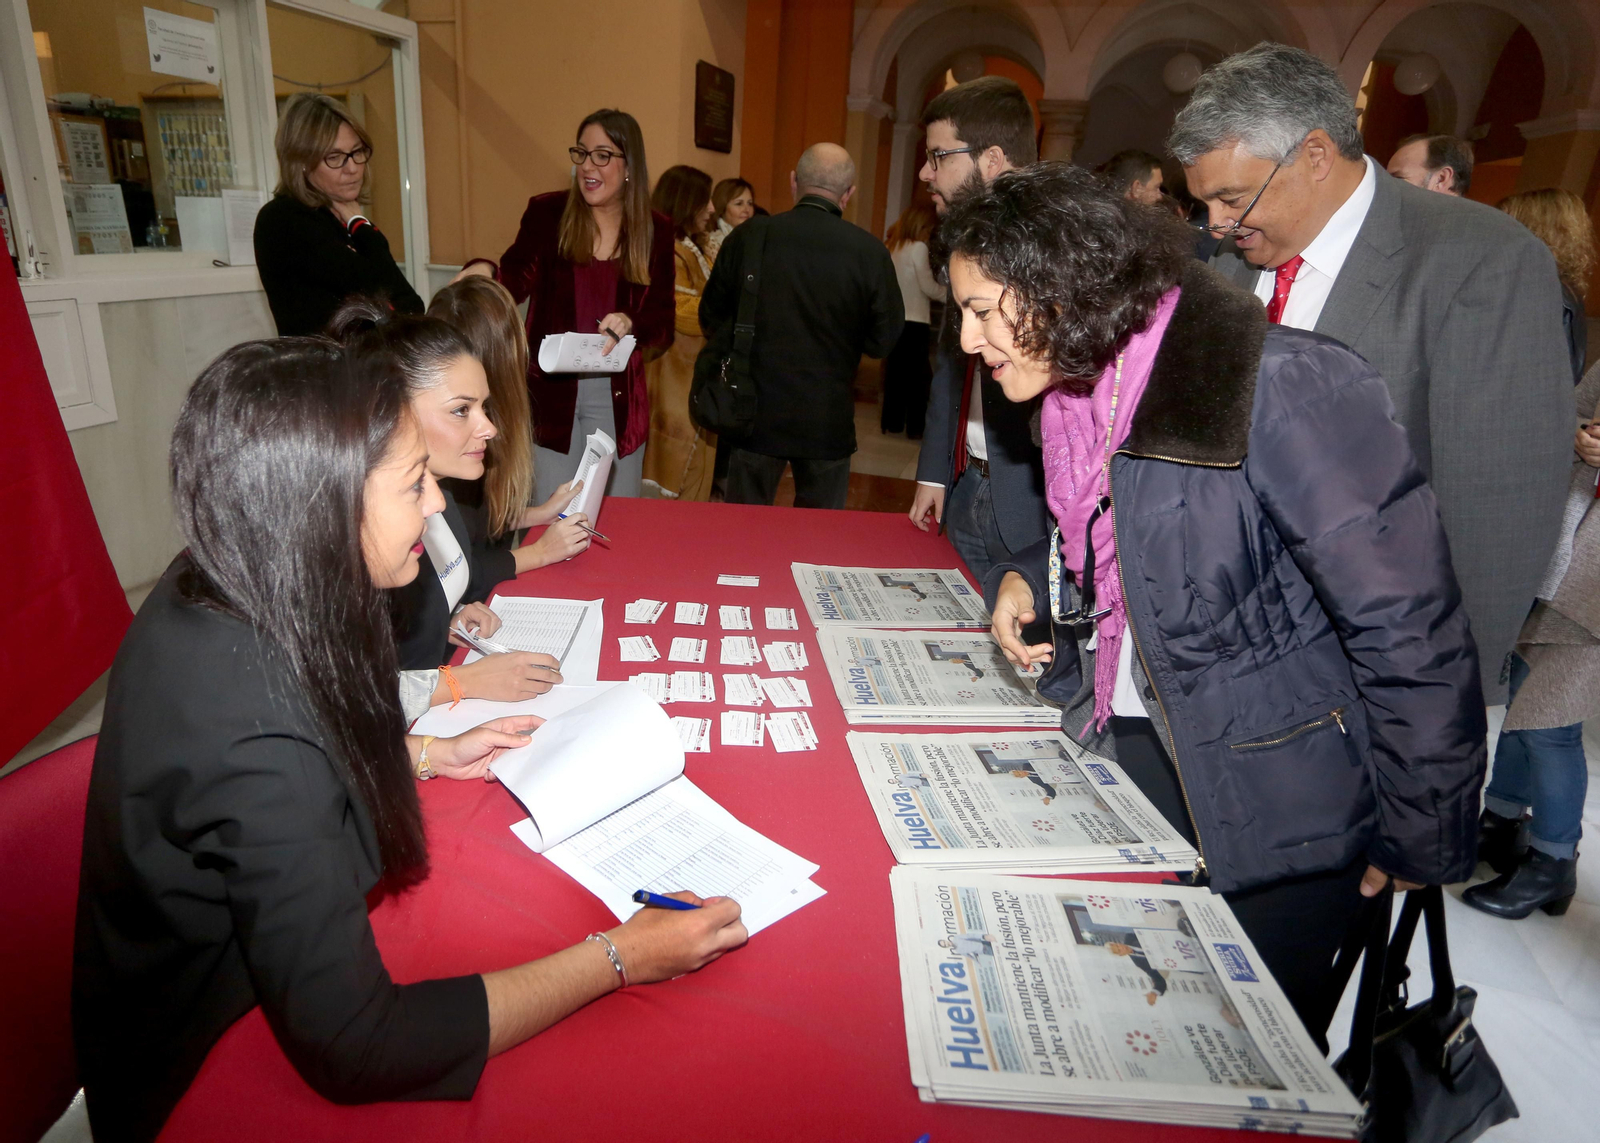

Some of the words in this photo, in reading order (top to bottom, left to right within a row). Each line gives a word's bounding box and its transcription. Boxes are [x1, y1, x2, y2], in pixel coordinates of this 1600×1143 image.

[816, 592, 842, 620] Huelva
[848, 668, 878, 705] Huelva
[921, 745, 936, 760] pero
[879, 743, 908, 791] Inormación
[943, 789, 968, 821] mantiene
[957, 788, 985, 821] modificar
[891, 792, 941, 849] Huelva
[966, 822, 984, 839] Junta
[1076, 820, 1101, 844] González
[1079, 811, 1097, 828] fuerte
[1090, 813, 1110, 831] liderar
[1106, 822, 1126, 836] PSOE
[976, 840, 988, 848] La
[980, 826, 998, 840] abre
[991, 892, 1009, 914] pero
[935, 885, 962, 960] Inormación
[1004, 890, 1032, 945] mejorable”
[997, 916, 1016, 949] fusión,
[1005, 951, 1020, 961] la
[1010, 963, 1036, 1021] mantiene
[1028, 964, 1056, 1022] modificar
[936, 962, 989, 1071] Huelva
[1257, 997, 1278, 1026] bloqueo
[1027, 1024, 1049, 1059] Junta
[1184, 1025, 1195, 1037] ve
[1197, 1023, 1218, 1054] fuerte
[1281, 1035, 1293, 1049] con
[1050, 1035, 1070, 1063] abre
[1212, 1027, 1237, 1062] liderar
[1040, 1061, 1056, 1076] La
[1061, 1065, 1077, 1078] se
[1190, 1039, 1222, 1083] González
[1213, 1056, 1233, 1077] Díaz
[1234, 1047, 1261, 1075] PSOE
[1278, 1049, 1297, 1069] alaba
[1290, 1050, 1312, 1075] acabar
[1233, 1064, 1256, 1085] para
[1294, 1071, 1307, 1083] Rey
[1310, 1076, 1327, 1093] para
